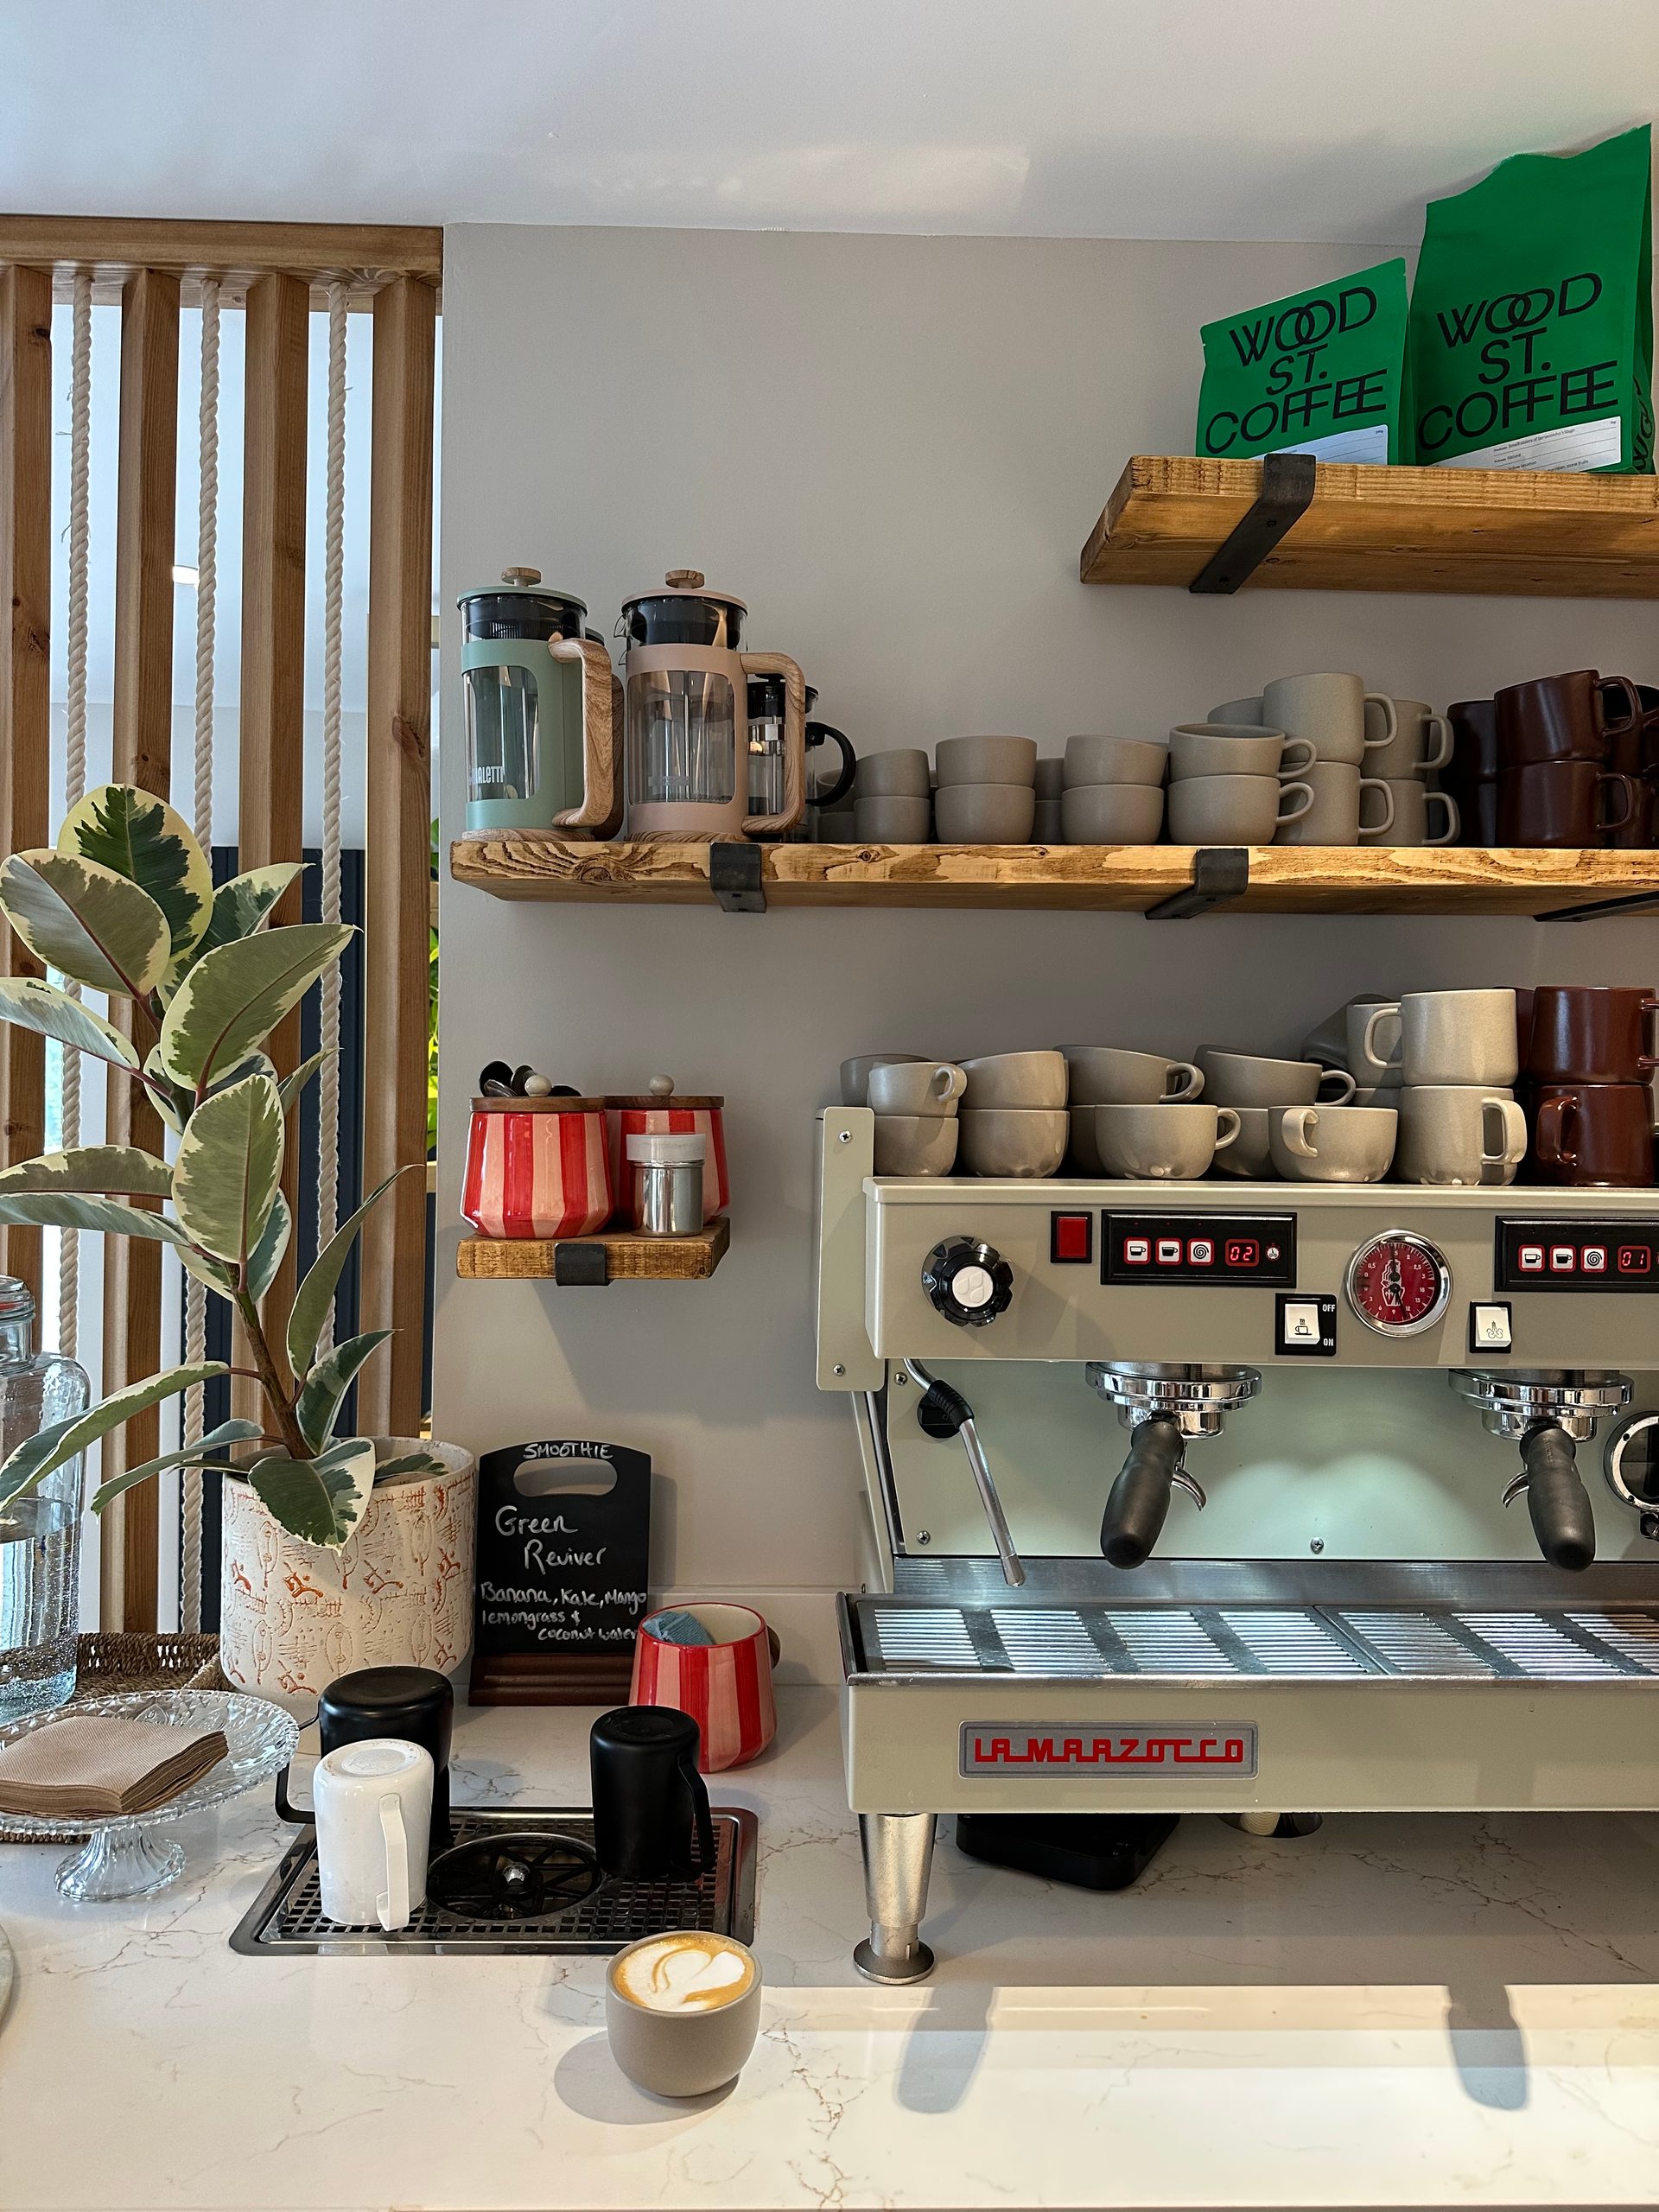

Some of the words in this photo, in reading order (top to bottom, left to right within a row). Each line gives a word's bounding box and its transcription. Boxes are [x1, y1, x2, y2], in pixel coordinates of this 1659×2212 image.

[1229, 285, 1377, 367] WOOD
[1436, 271, 1603, 349] WOOD
[1265, 343, 1328, 397] ST.
[1478, 326, 1551, 386] ST.
[1205, 367, 1388, 454] COFFEE
[1417, 359, 1618, 451] COFFEE
[1230, 1246, 1253, 1262] 02
[1622, 1252, 1644, 1267] 01
[1322, 1303, 1336, 1313] OFF
[1323, 1338, 1334, 1346] ON
[523, 1442, 614, 1459] SMOOTHIE
[495, 1505, 579, 1536] Green
[524, 1538, 607, 1575] Reviver
[480, 1581, 558, 1605] Banana,
[604, 1589, 647, 1615] Mango
[482, 1610, 566, 1630] lemongrass
[975, 1738, 1010, 1763] LA
